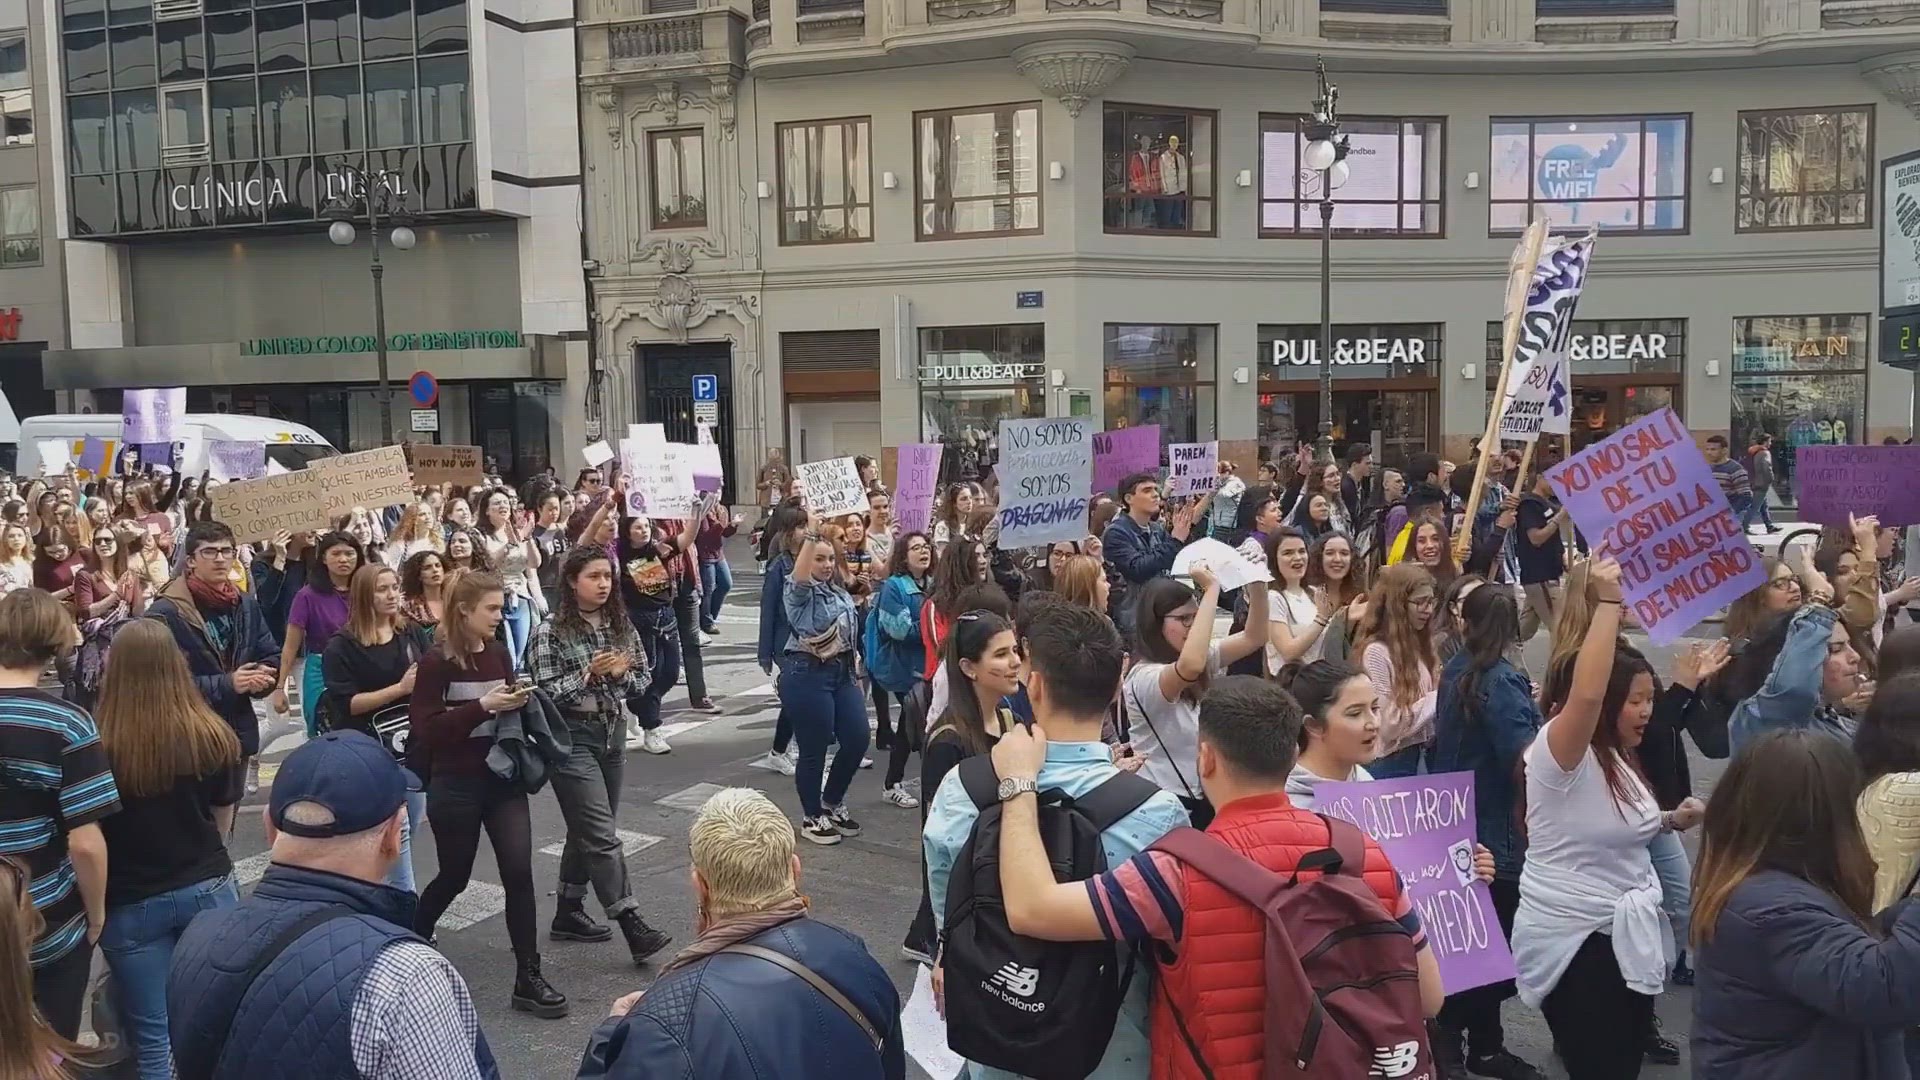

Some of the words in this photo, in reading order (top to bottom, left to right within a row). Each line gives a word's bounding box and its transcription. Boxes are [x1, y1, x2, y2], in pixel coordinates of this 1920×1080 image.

[1548, 181, 1593, 198] WIFI
[751, 295, 757, 307] 2
[248, 336, 313, 356] UNITED
[316, 335, 386, 354] COLOR
[391, 333, 416, 351] OF
[934, 363, 1024, 380] PULL&BEAR
[698, 379, 711, 398] P
[293, 434, 314, 444] GLS
[1008, 426, 1030, 451] NO
[1035, 422, 1082, 447] SOMOS
[384, 449, 403, 461] LA
[419, 459, 437, 468] HOY
[442, 459, 456, 468] NO
[460, 459, 476, 468] VOY
[1552, 462, 1590, 497] YO
[1586, 443, 1626, 481] NO
[266, 479, 283, 489] AL
[352, 482, 411, 504] NUESTRAS
[1019, 473, 1071, 498] SOMOS
[1600, 475, 1644, 514] DE
[1633, 455, 1677, 494] TU
[828, 491, 845, 503] NO
[219, 503, 241, 518] ES
[1603, 482, 1714, 555] COSTILLA
[1652, 508, 1742, 573] SALISTE
[1634, 588, 1674, 629] DE
[1664, 574, 1696, 610] MI
[1690, 546, 1753, 598] COÑO
[1362, 785, 1470, 841] QUITARON
[1416, 885, 1489, 958] MIEDO
[981, 980, 1000, 997] new
[1001, 990, 1045, 1013] balance
